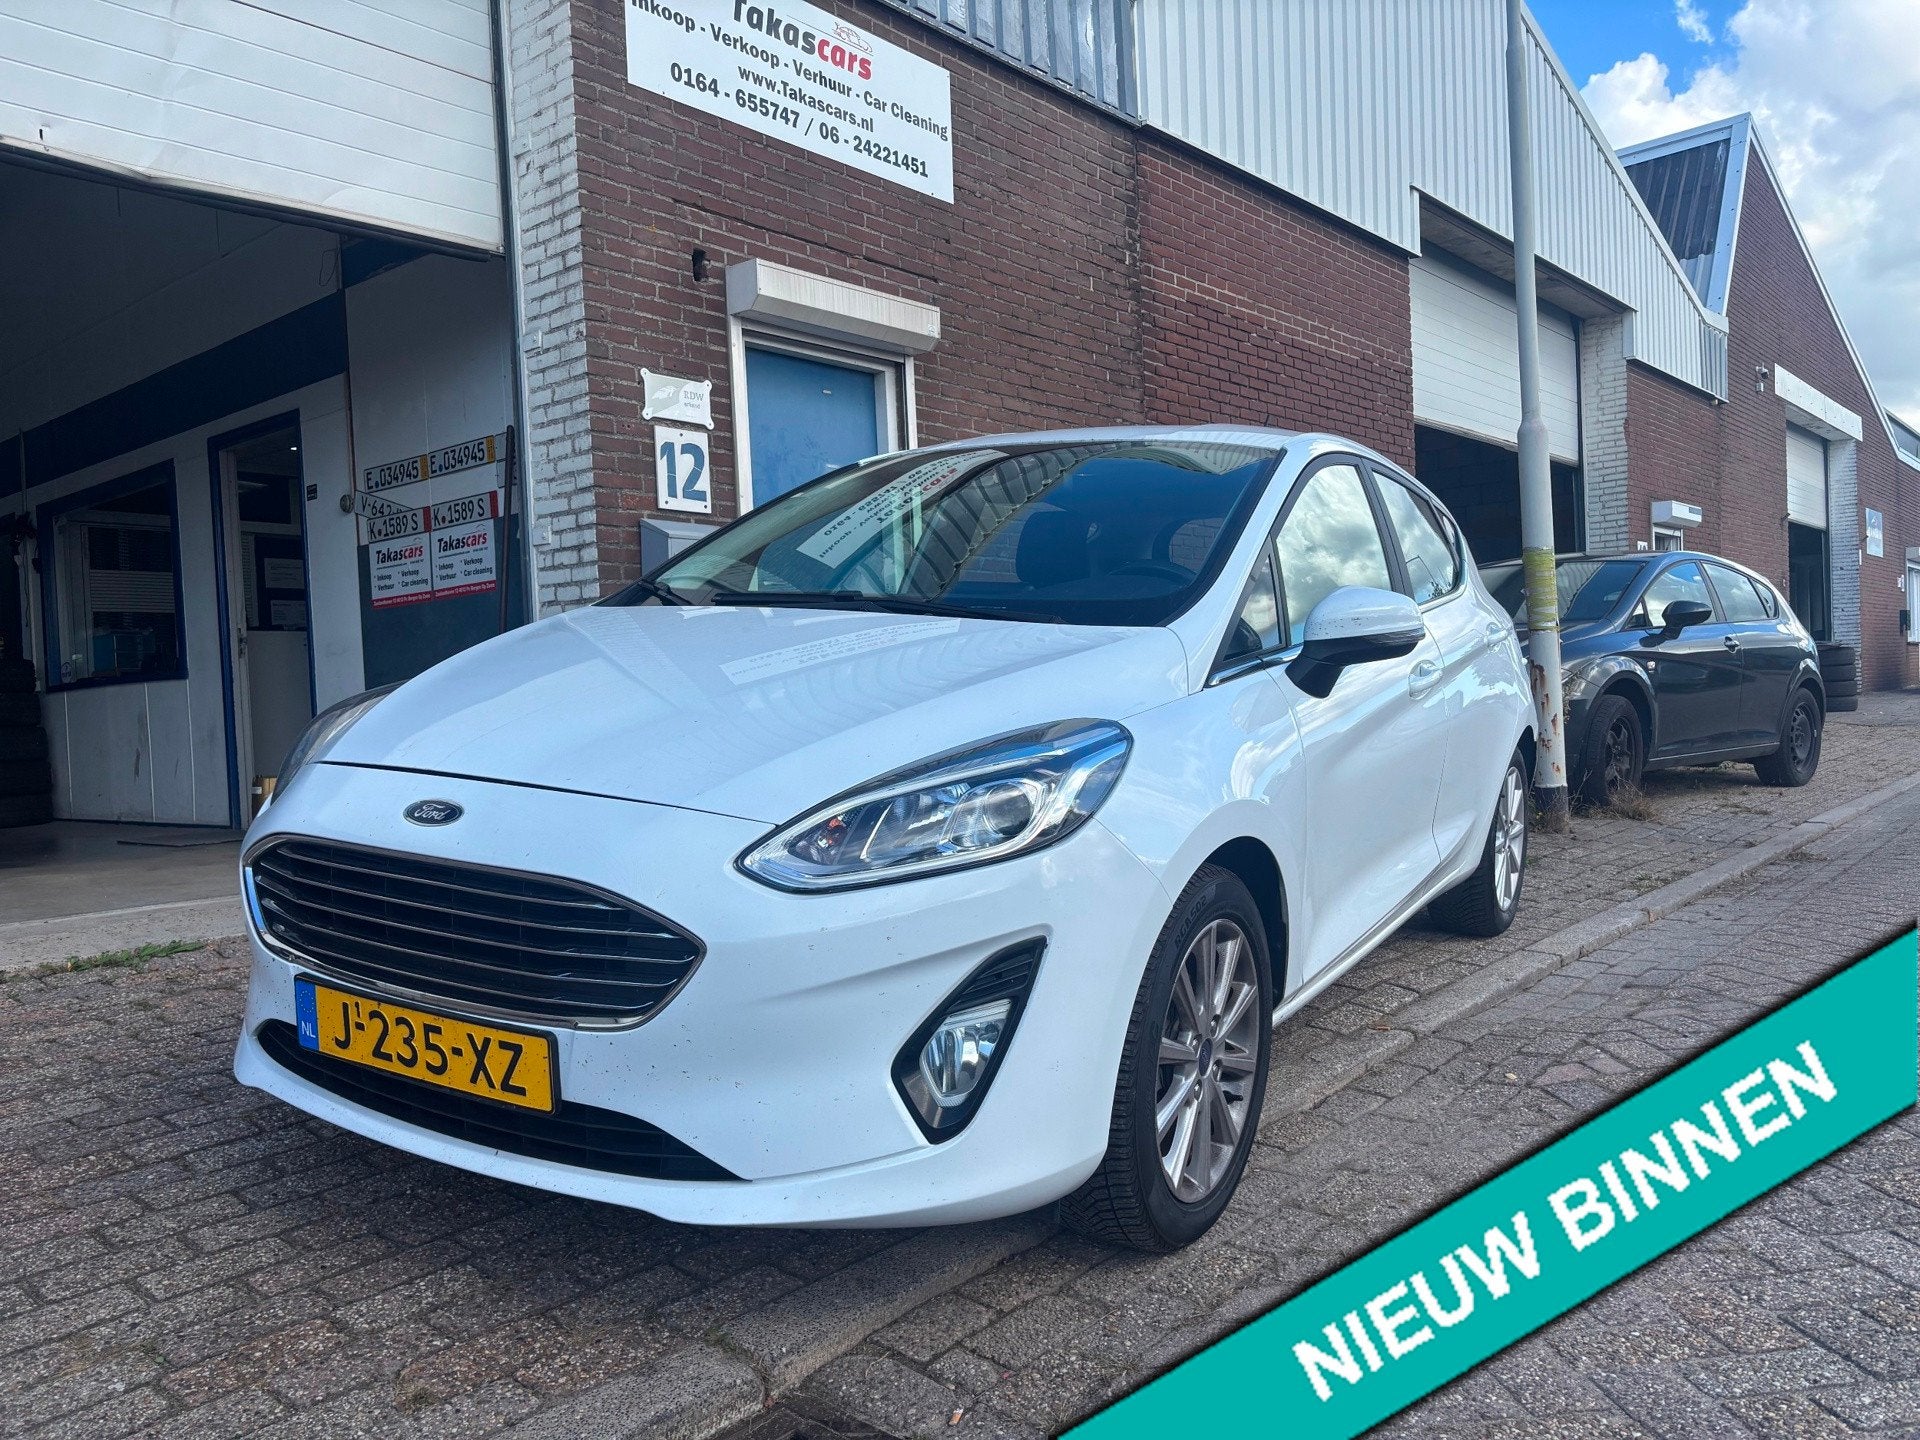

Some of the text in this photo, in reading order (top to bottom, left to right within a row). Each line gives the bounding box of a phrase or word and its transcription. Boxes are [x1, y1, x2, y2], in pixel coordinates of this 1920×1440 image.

[733, 0, 872, 80] Takascars
[710, 23, 780, 69] Verkoop
[793, 59, 852, 99] Verhuur
[864, 90, 888, 113] Car
[891, 101, 948, 142] Cleaning
[737, 66, 874, 133] www.Takascars.nl
[670, 62, 720, 98] 0164
[735, 89, 800, 129] 655747
[819, 122, 840, 145] 06
[853, 134, 929, 178] 24221451
[683, 390, 704, 402] RDW
[660, 441, 707, 502] 12
[375, 545, 424, 565] Takascars
[437, 532, 487, 553] Takascars
[413, 802, 447, 822] Ford
[301, 1020, 316, 1038] NL
